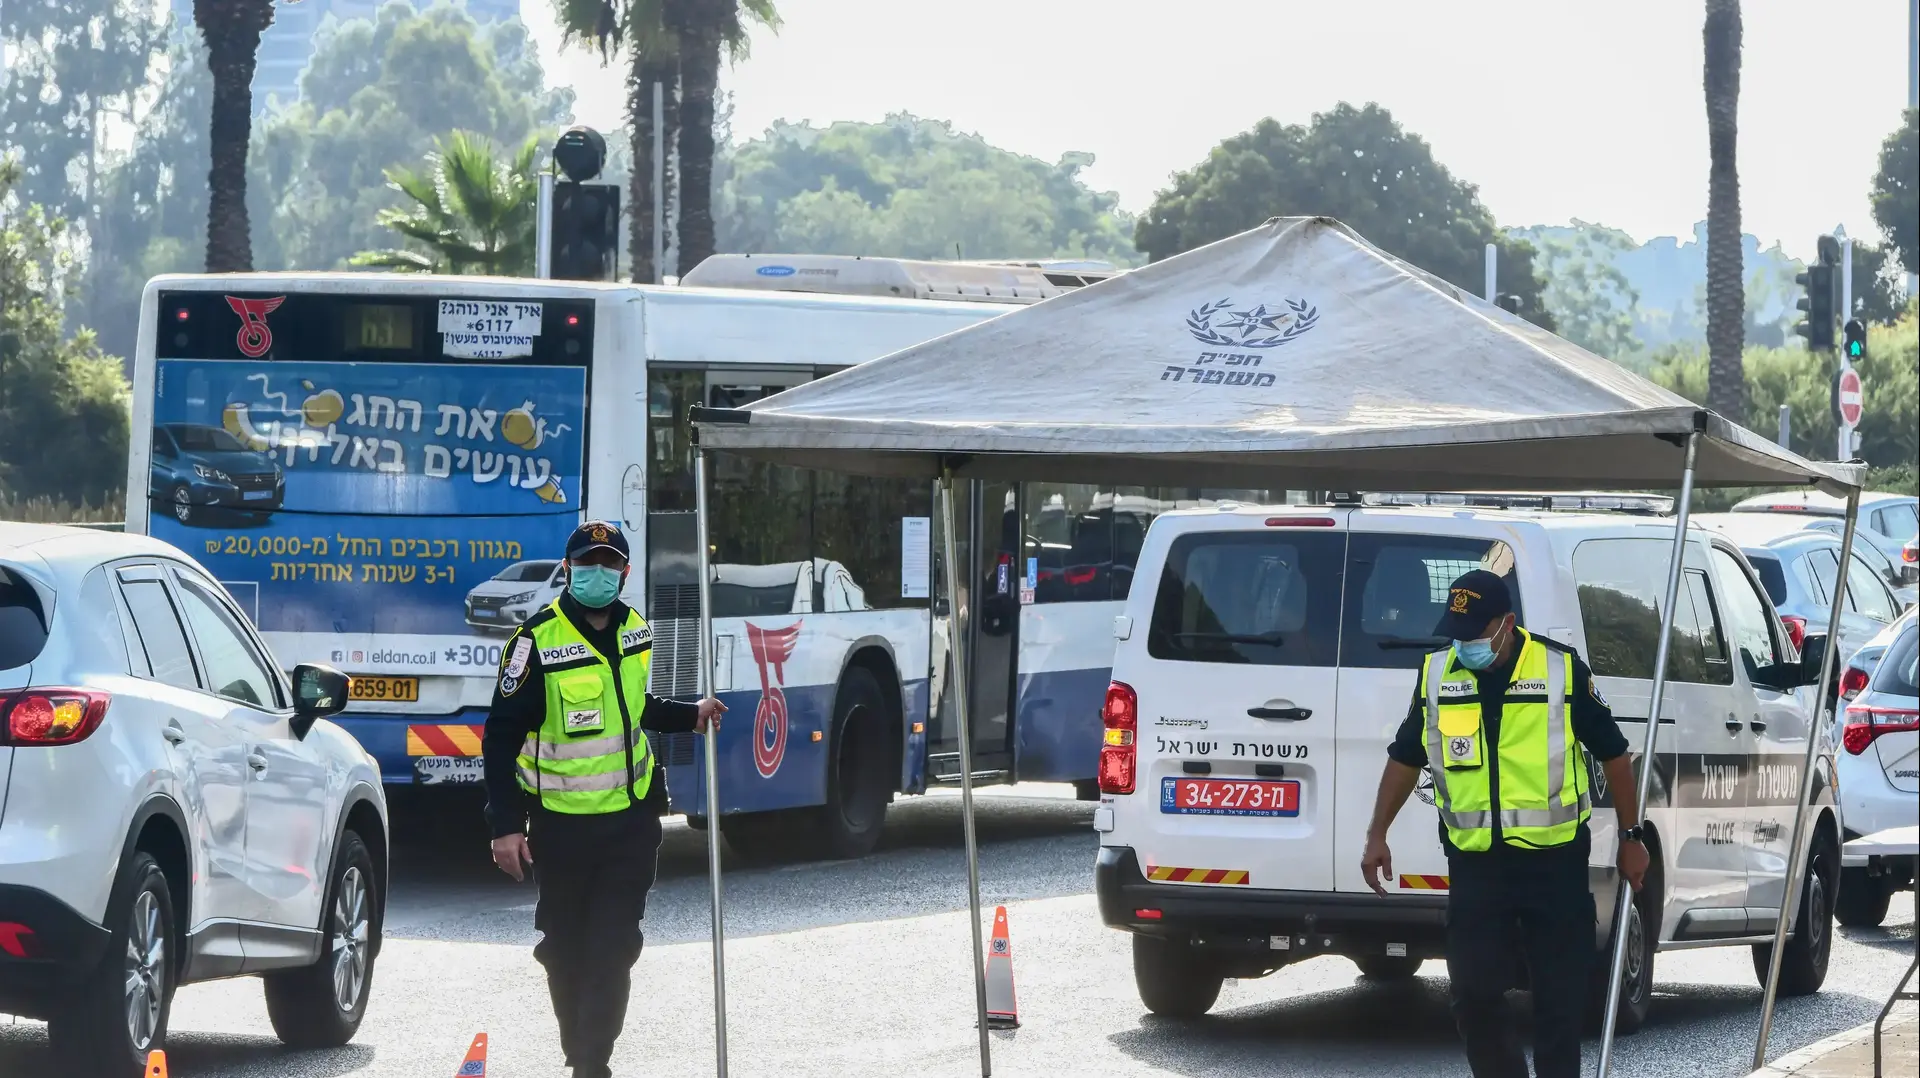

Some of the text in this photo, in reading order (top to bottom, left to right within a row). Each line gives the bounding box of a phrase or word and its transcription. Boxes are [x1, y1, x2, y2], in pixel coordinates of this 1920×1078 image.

[441, 302, 540, 320] איך אני נוהג?
[445, 332, 532, 345] האוטובוס מעשן!
[1160, 366, 1277, 387] משטרה
[346, 393, 498, 441] את החג
[268, 420, 552, 490] עושים באלדן!
[224, 536, 329, 558] מ-20,000
[337, 533, 381, 556] החל
[391, 539, 460, 558] רכבים
[468, 540, 522, 562] מגוון
[270, 561, 455, 584] ו-3 שנות אחריות
[372, 649, 436, 665] eldan.co.il
[543, 644, 586, 660] POLICE
[1441, 683, 1473, 692] POLICE
[1157, 735, 1309, 758] משטרת ישראל
[1701, 754, 1798, 800] משטרת ישראל
[1705, 822, 1735, 845] POLICE
